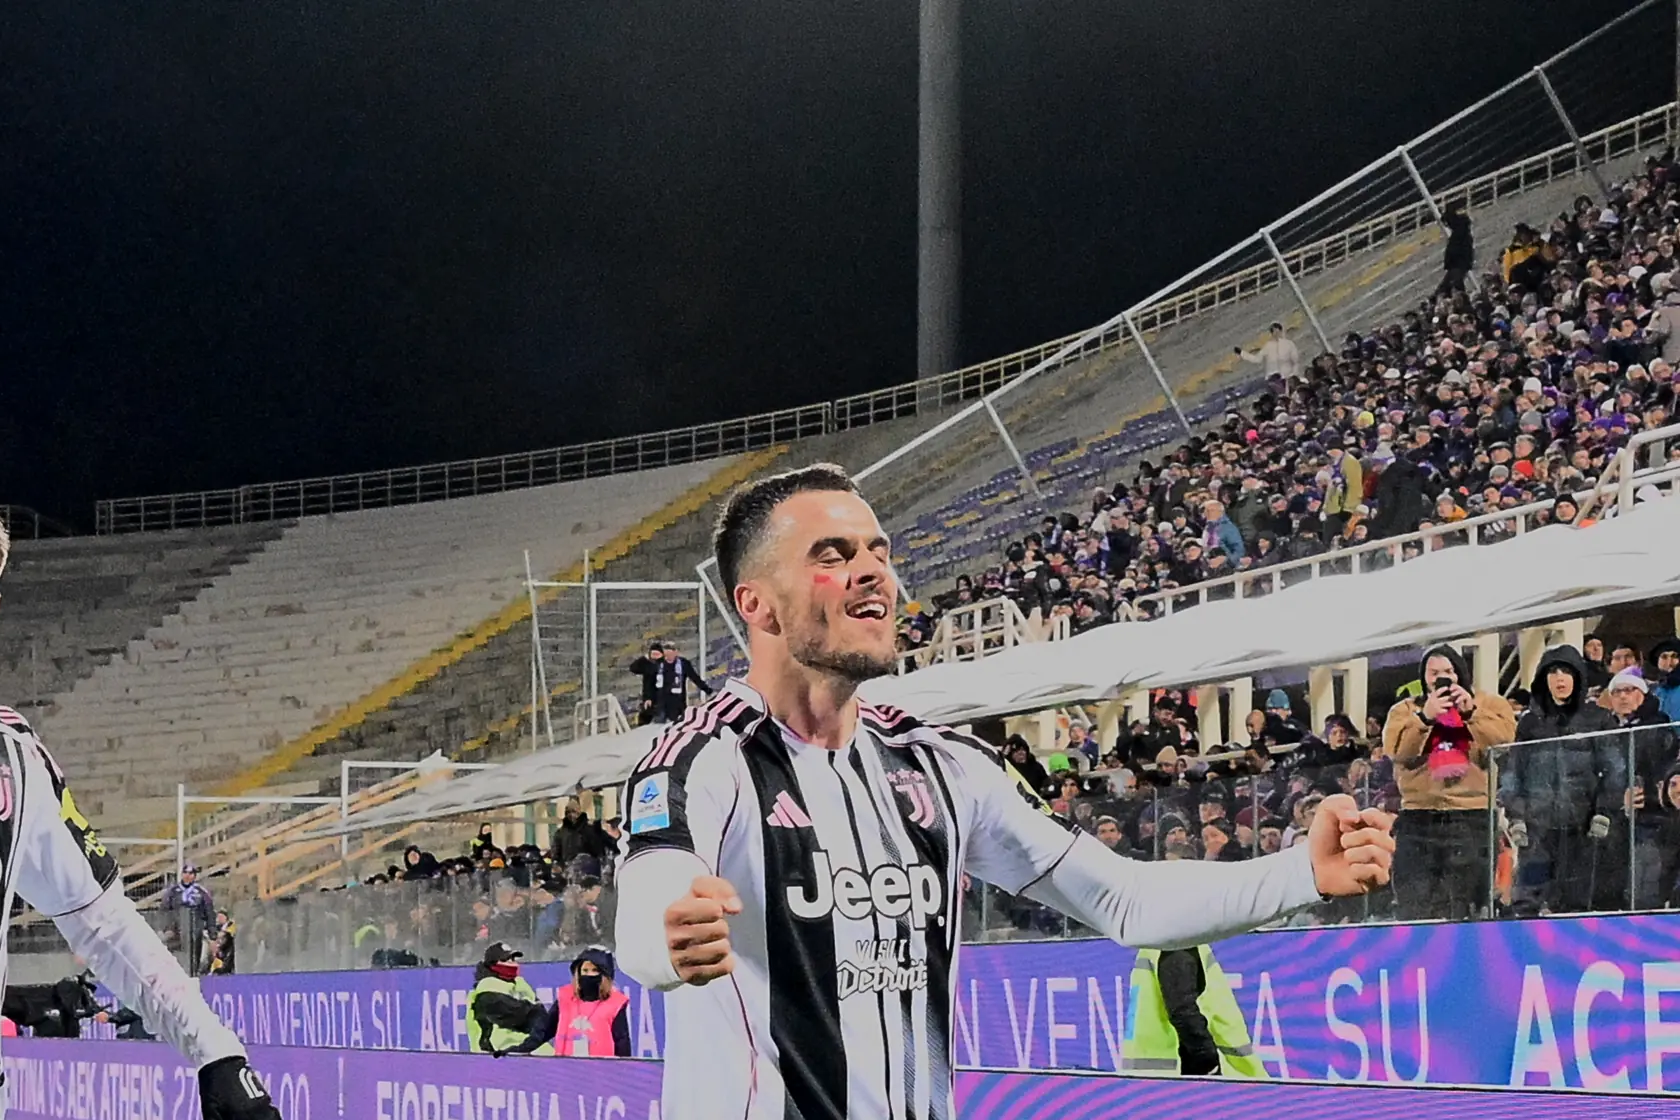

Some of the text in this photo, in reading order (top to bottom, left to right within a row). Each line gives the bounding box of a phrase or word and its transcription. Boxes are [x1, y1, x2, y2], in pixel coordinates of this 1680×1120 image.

[786, 848, 942, 929] Jeep
[836, 959, 927, 1001] Detroit
[252, 993, 271, 1045] IN
[1324, 966, 1430, 1084] SU
[48, 1060, 65, 1119] VS
